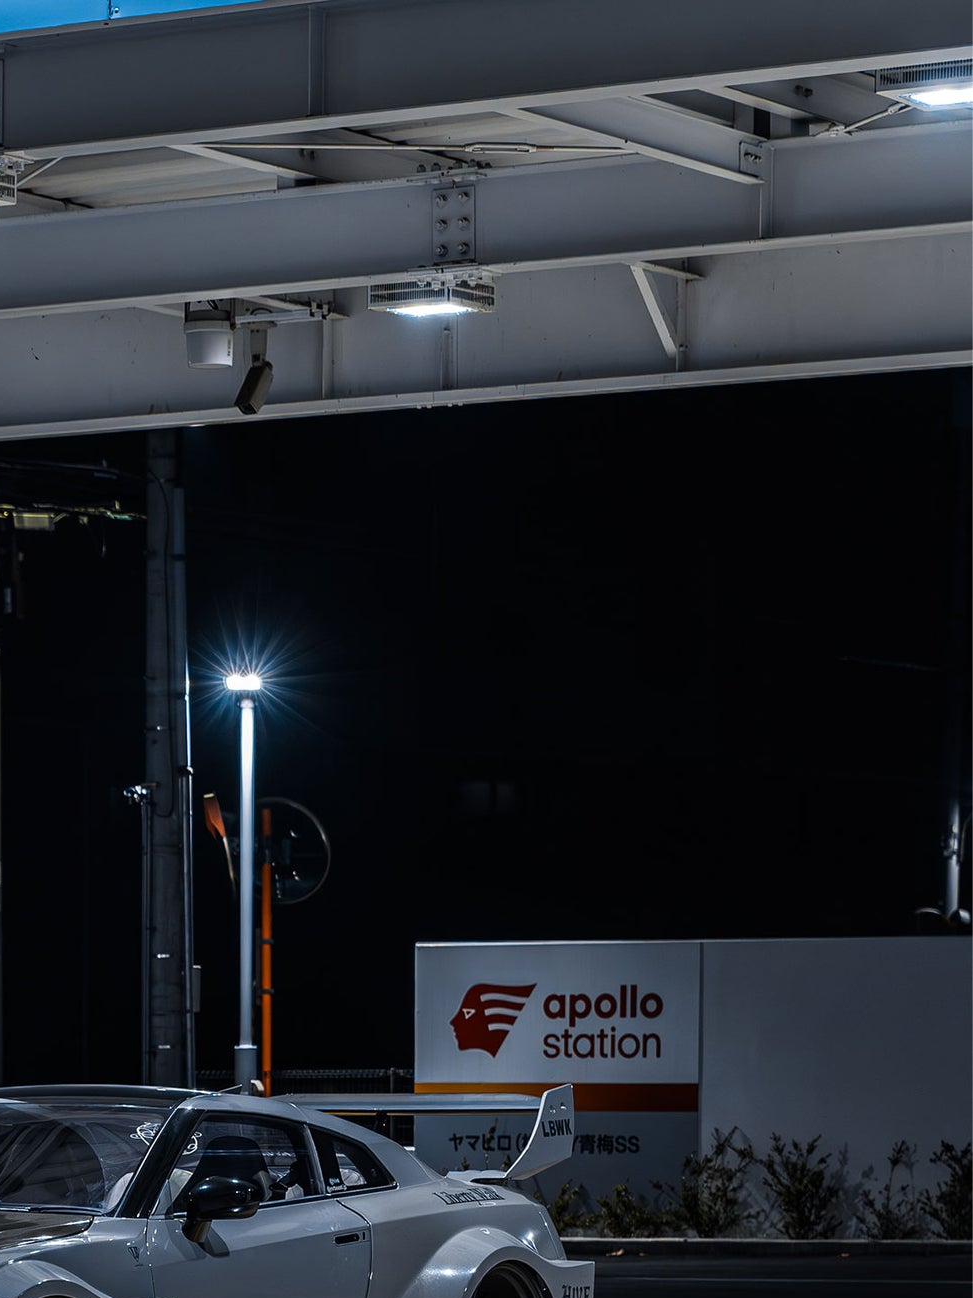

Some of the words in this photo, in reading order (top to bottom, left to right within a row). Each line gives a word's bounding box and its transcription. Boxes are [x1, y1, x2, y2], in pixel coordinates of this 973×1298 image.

[542, 984, 664, 1028] apollo
[542, 1027, 662, 1059] station
[541, 1118, 573, 1138] LBWK
